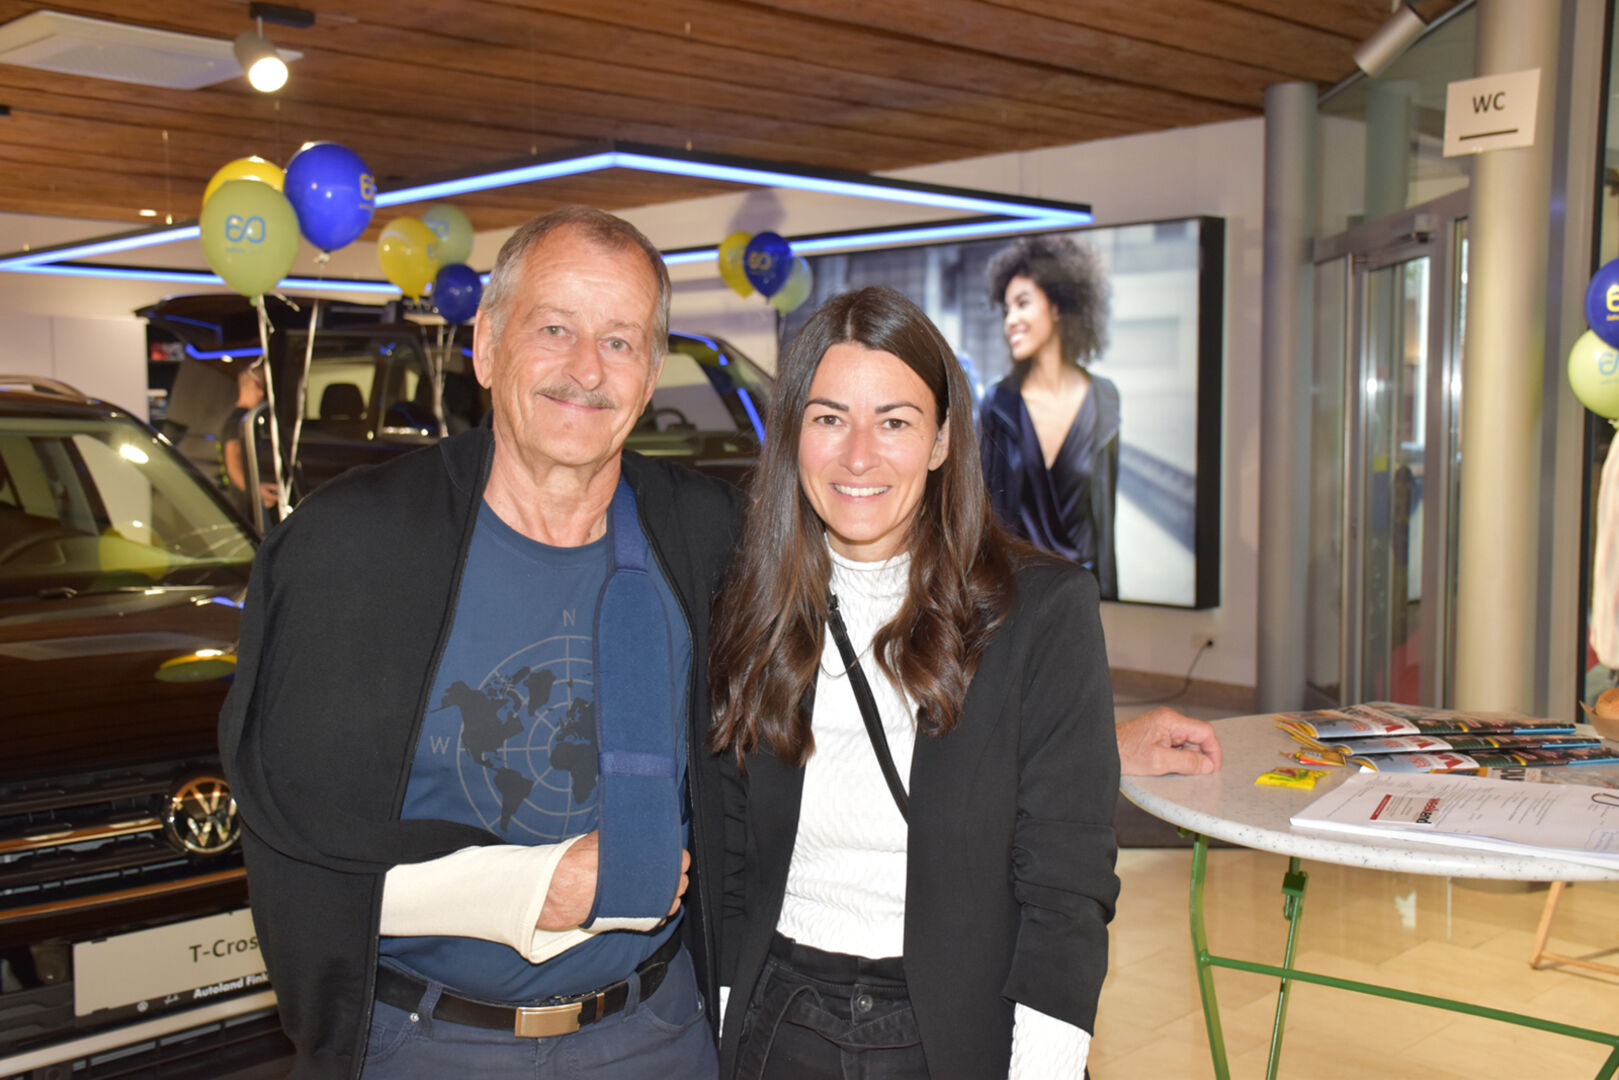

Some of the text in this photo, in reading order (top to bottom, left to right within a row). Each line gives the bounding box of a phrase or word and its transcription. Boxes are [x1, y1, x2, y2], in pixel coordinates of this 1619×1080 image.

[1472, 91, 1506, 114] WC
[225, 214, 266, 244] 60
[562, 608, 576, 627] N
[430, 735, 450, 755] W
[193, 977, 244, 999] Autoland
